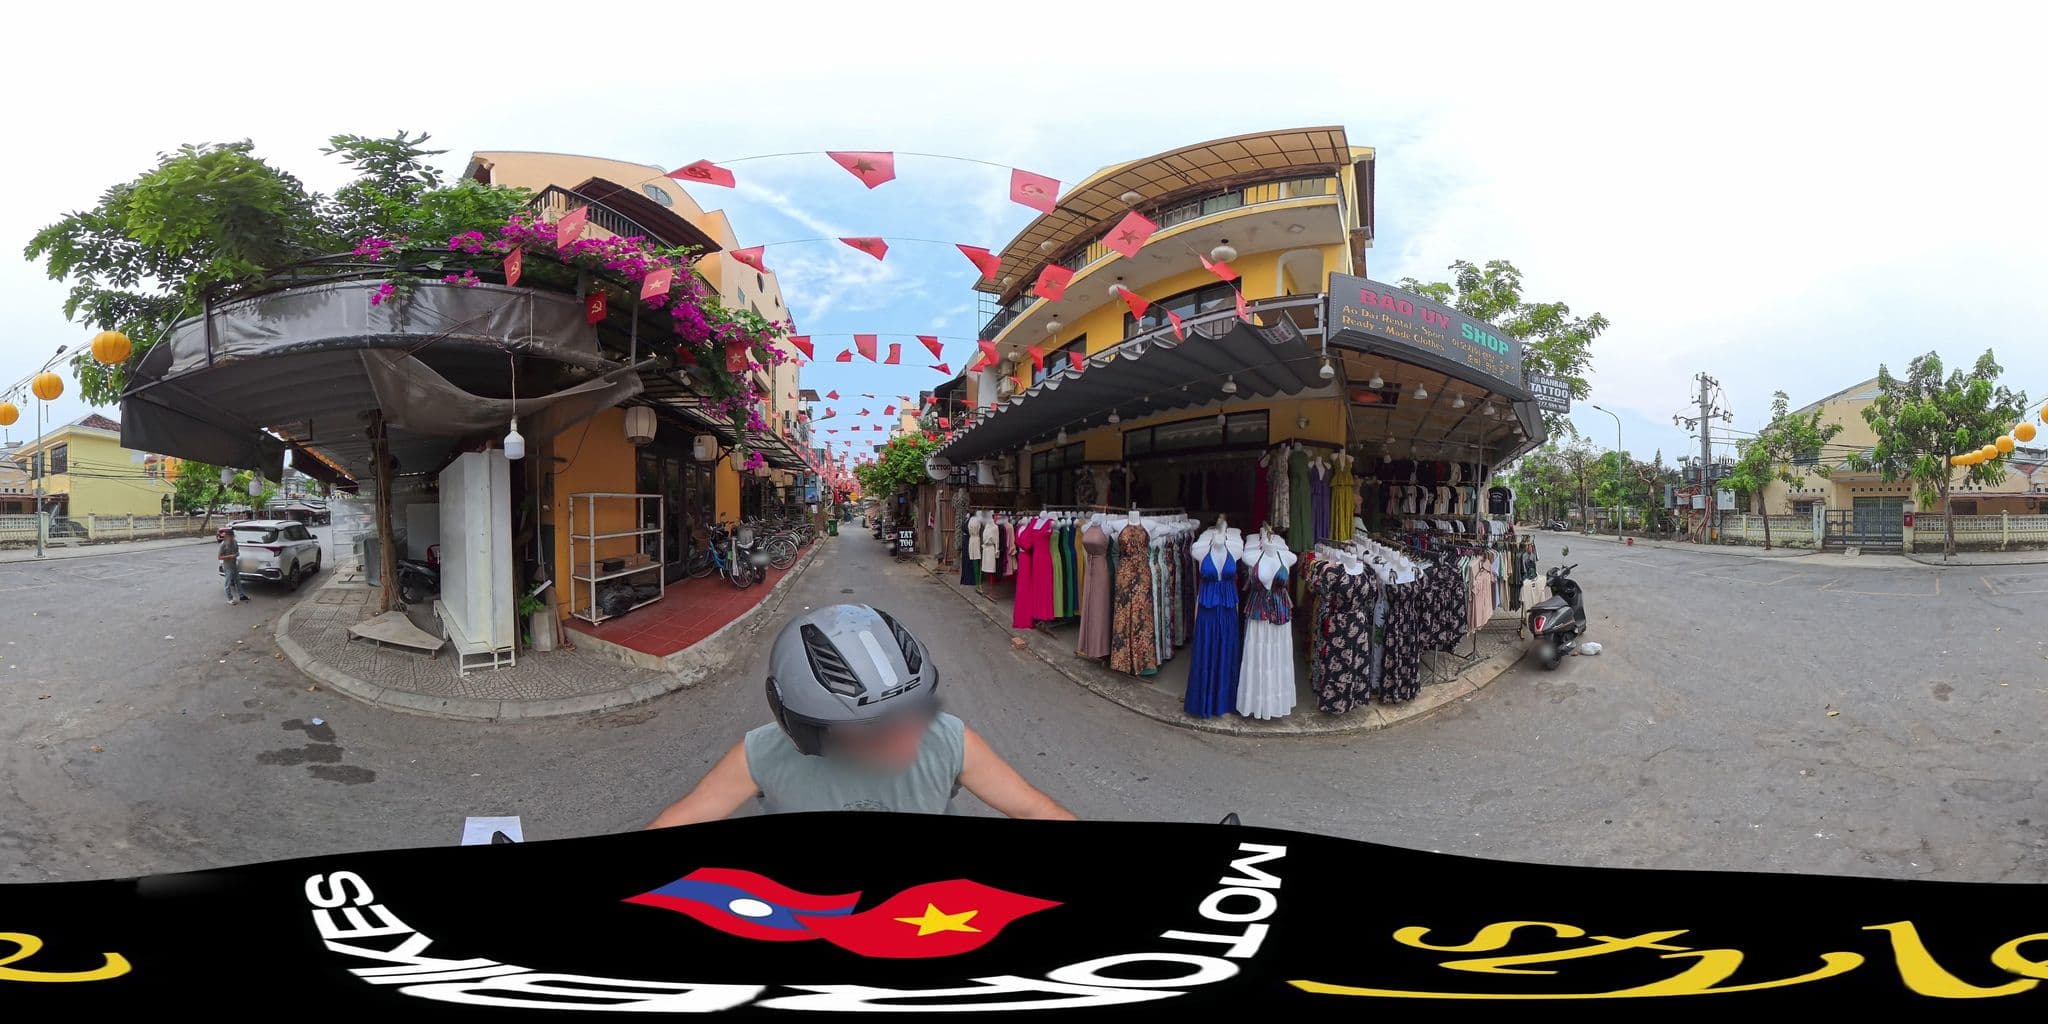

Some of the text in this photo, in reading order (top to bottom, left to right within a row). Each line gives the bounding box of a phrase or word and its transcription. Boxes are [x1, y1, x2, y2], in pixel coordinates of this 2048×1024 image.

[1382, 313, 1412, 329] Rental
[1343, 315, 1375, 331] Ready
[1385, 325, 1412, 340] Made
[1413, 334, 1445, 352] Clothes
[1461, 322, 1509, 356] SHOP
[1530, 382, 1568, 399] TATTOO
[899, 530, 914, 538] TAT
[899, 539, 913, 547] TOO
[857, 676, 921, 707] LS2
